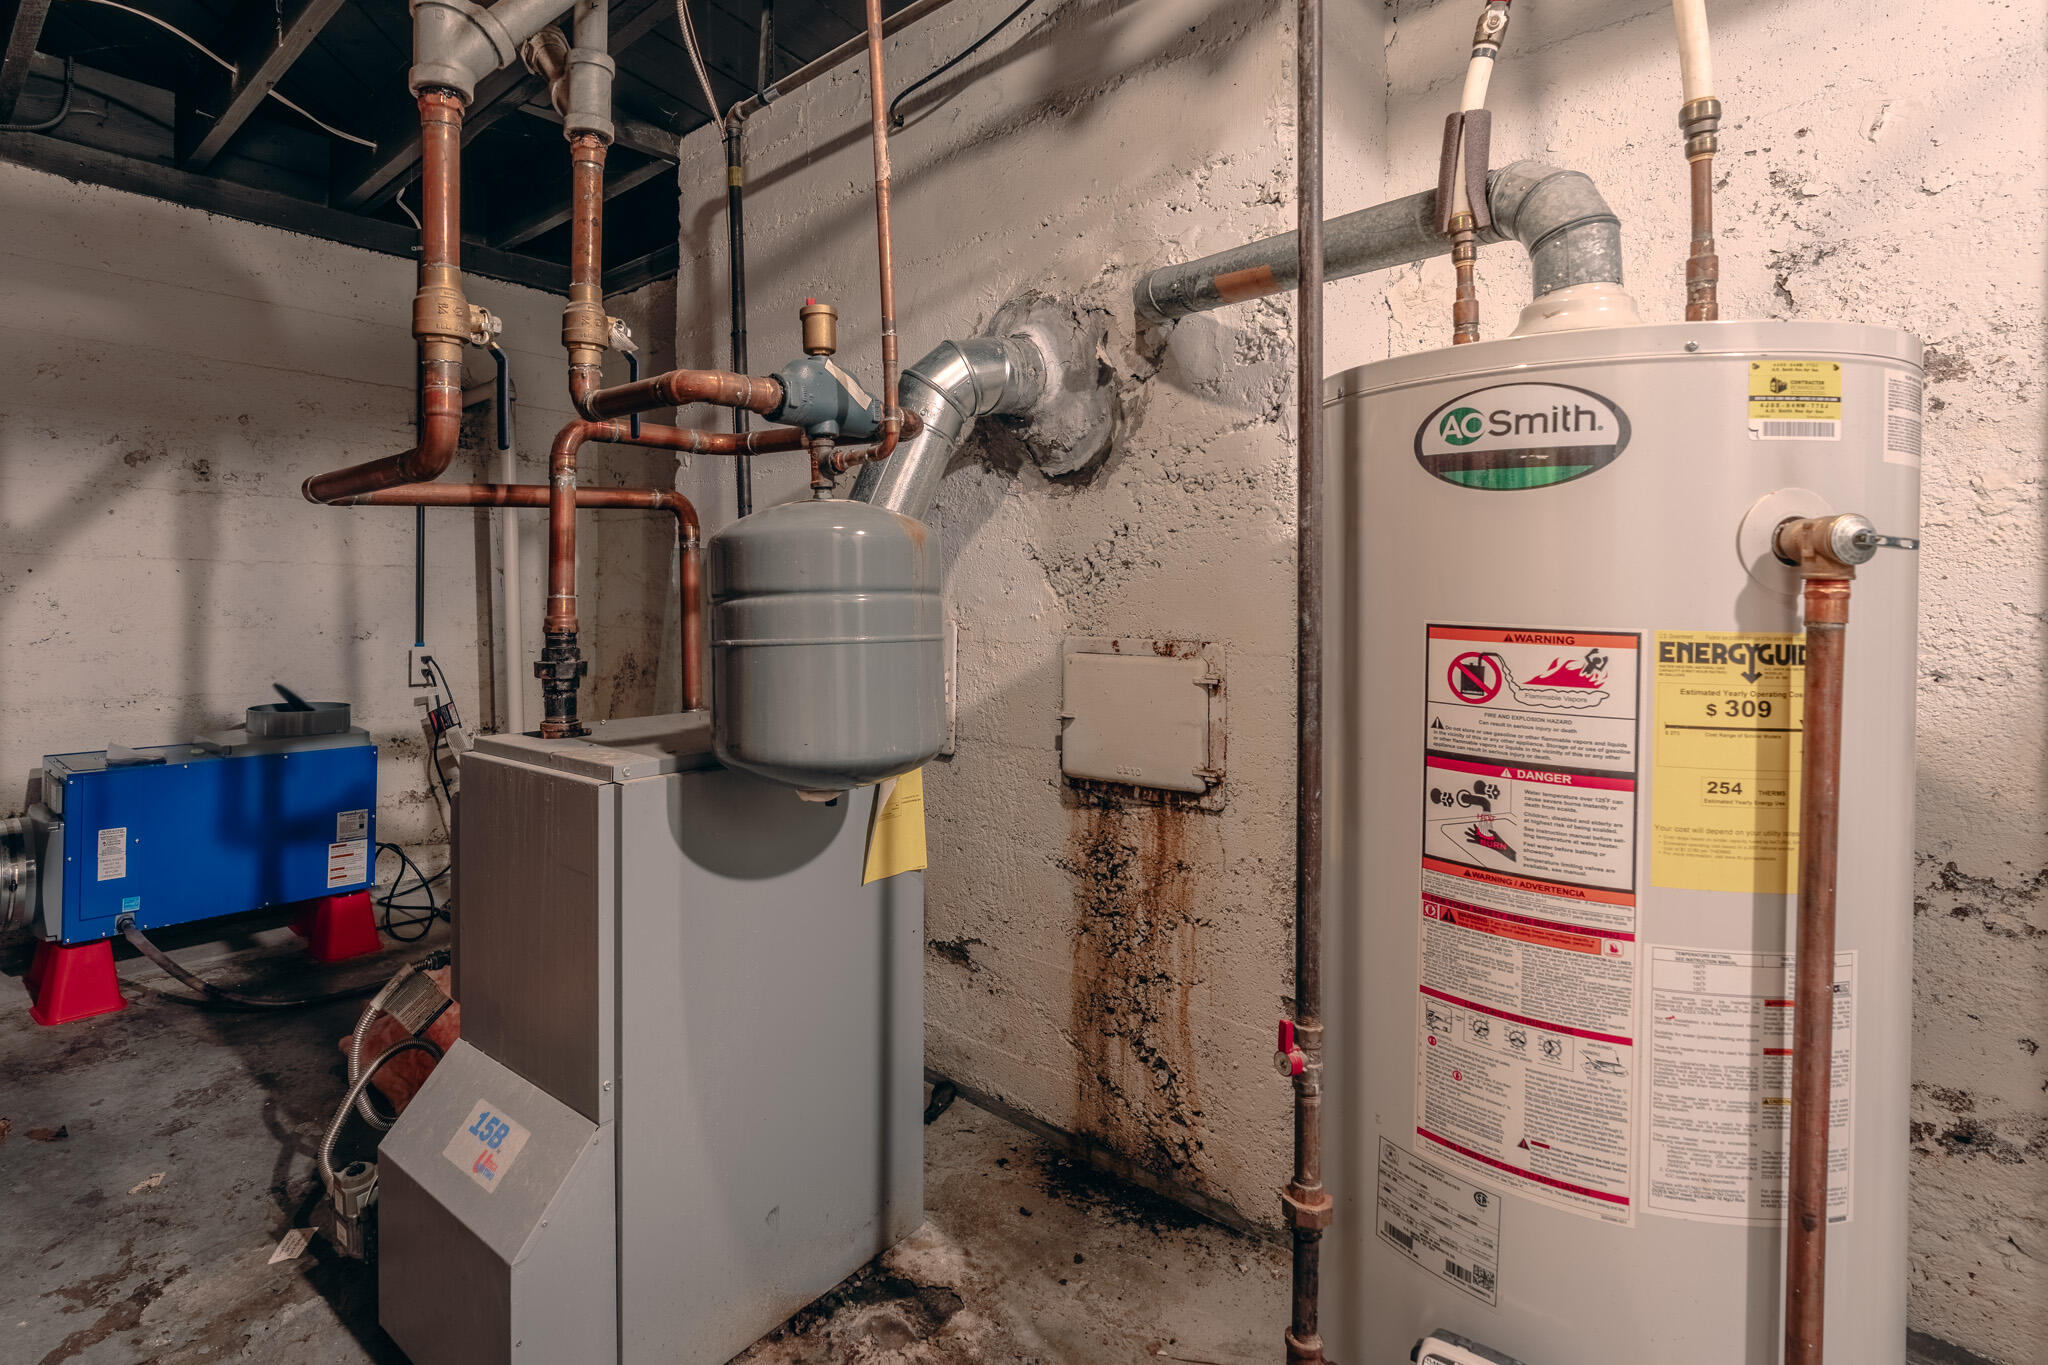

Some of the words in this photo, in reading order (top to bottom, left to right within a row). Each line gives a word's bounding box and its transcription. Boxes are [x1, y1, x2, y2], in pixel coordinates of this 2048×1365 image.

[1514, 634, 1575, 645] WARNING
[1524, 692, 1562, 700] Flammable
[1680, 688, 1720, 696] Estimated
[1724, 690, 1747, 698] Yearly
[1750, 690, 1787, 699] Operating
[1725, 700, 1772, 718] 309
[1511, 714, 1546, 723] EXPLOSION
[1546, 717, 1573, 725] HAZARD
[1516, 770, 1572, 784] DANGER
[1707, 782, 1742, 795] 254
[1480, 840, 1507, 850] BURN
[1472, 872, 1512, 886] WARNING
[1519, 880, 1585, 898] ADVERTENCIA
